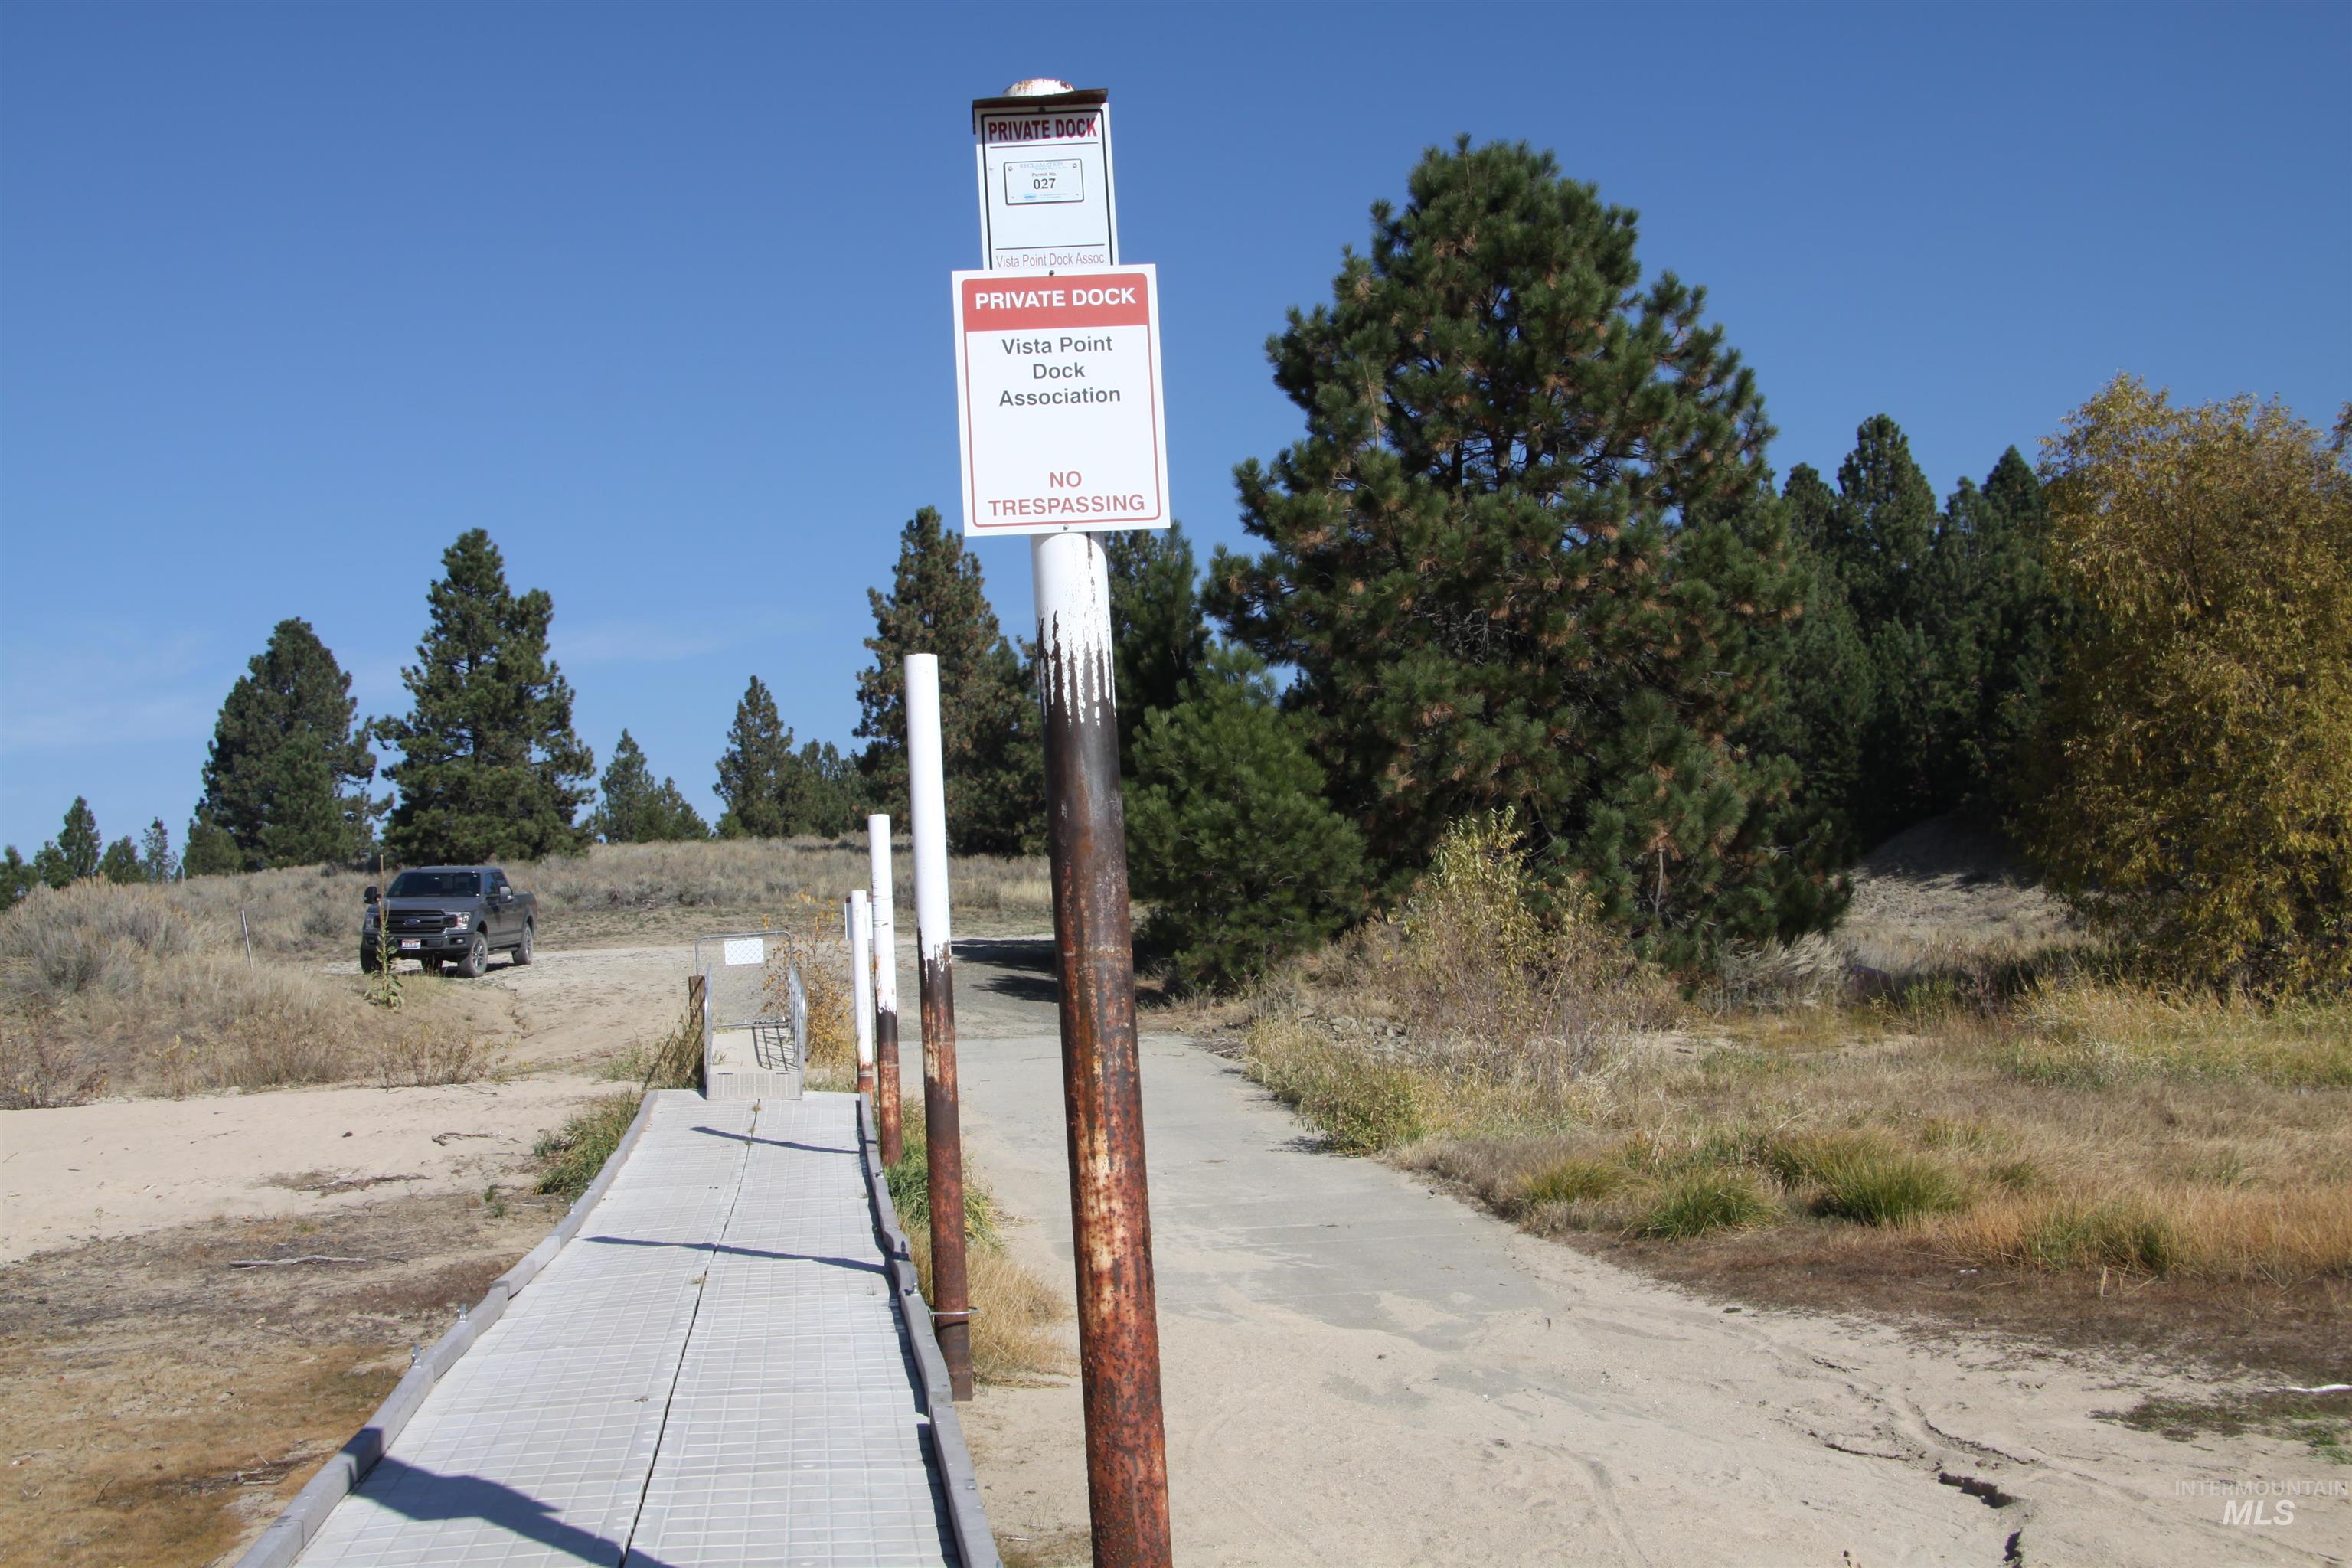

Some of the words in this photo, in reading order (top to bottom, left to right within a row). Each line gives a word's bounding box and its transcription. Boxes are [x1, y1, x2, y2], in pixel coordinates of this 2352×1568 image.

[988, 119, 1050, 141] PRIVATE
[1055, 117, 1097, 139] DOCK
[1033, 178, 1056, 189] 027
[996, 255, 1019, 268] Vista
[1023, 253, 1047, 267] Point
[1050, 253, 1073, 266] Dock
[1076, 251, 1107, 264] Assoc.
[975, 290, 1066, 309] PRIVATE
[1072, 288, 1136, 306] DOCK
[1002, 338, 1052, 354] Vista
[1060, 336, 1112, 353] Point
[1032, 362, 1085, 380] Dock
[999, 387, 1121, 407] Association
[1049, 471, 1082, 488] NO
[988, 494, 1145, 517] TRESPASSING
